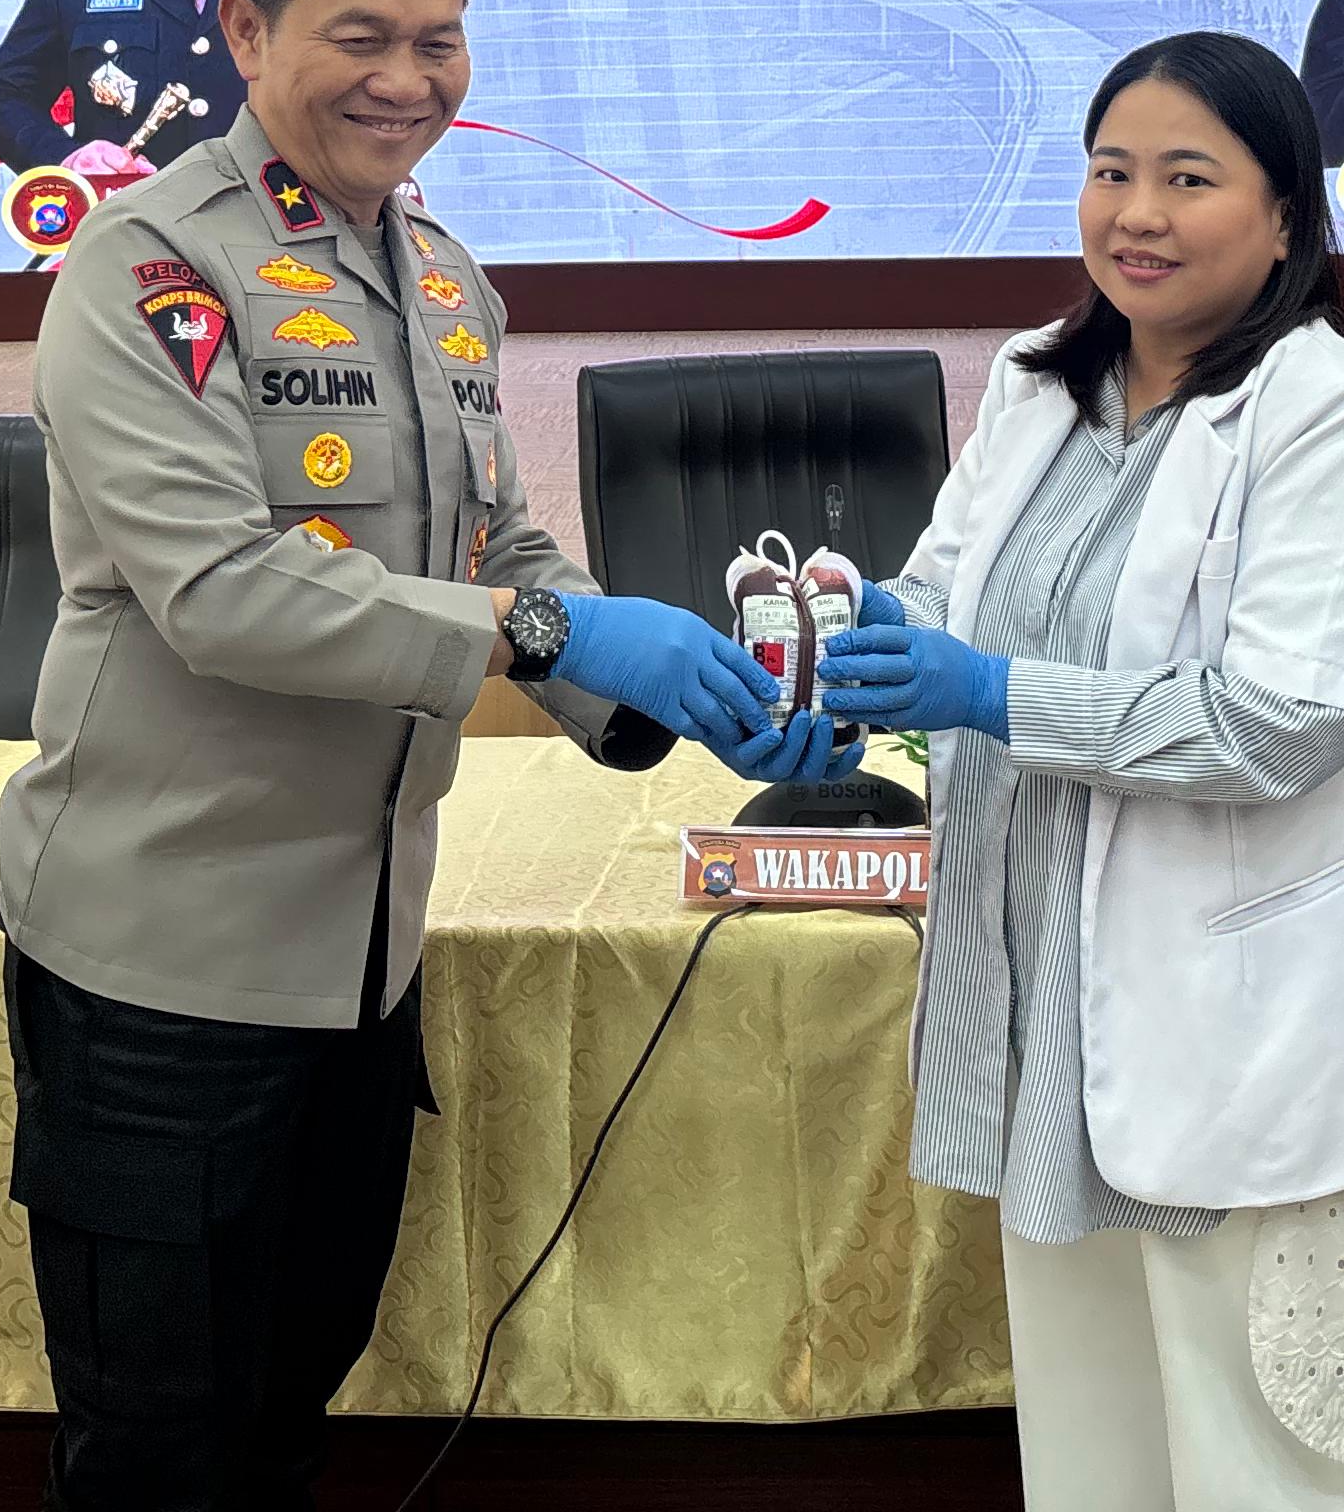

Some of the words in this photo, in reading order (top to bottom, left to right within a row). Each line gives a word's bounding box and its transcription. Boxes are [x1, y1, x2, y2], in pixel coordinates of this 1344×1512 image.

[143, 263, 206, 288] PELO
[144, 291, 186, 316] KORPS
[261, 368, 377, 407] SOLIHIN
[818, 783, 882, 799] BOSCH
[753, 848, 931, 892] WAKAPOL
